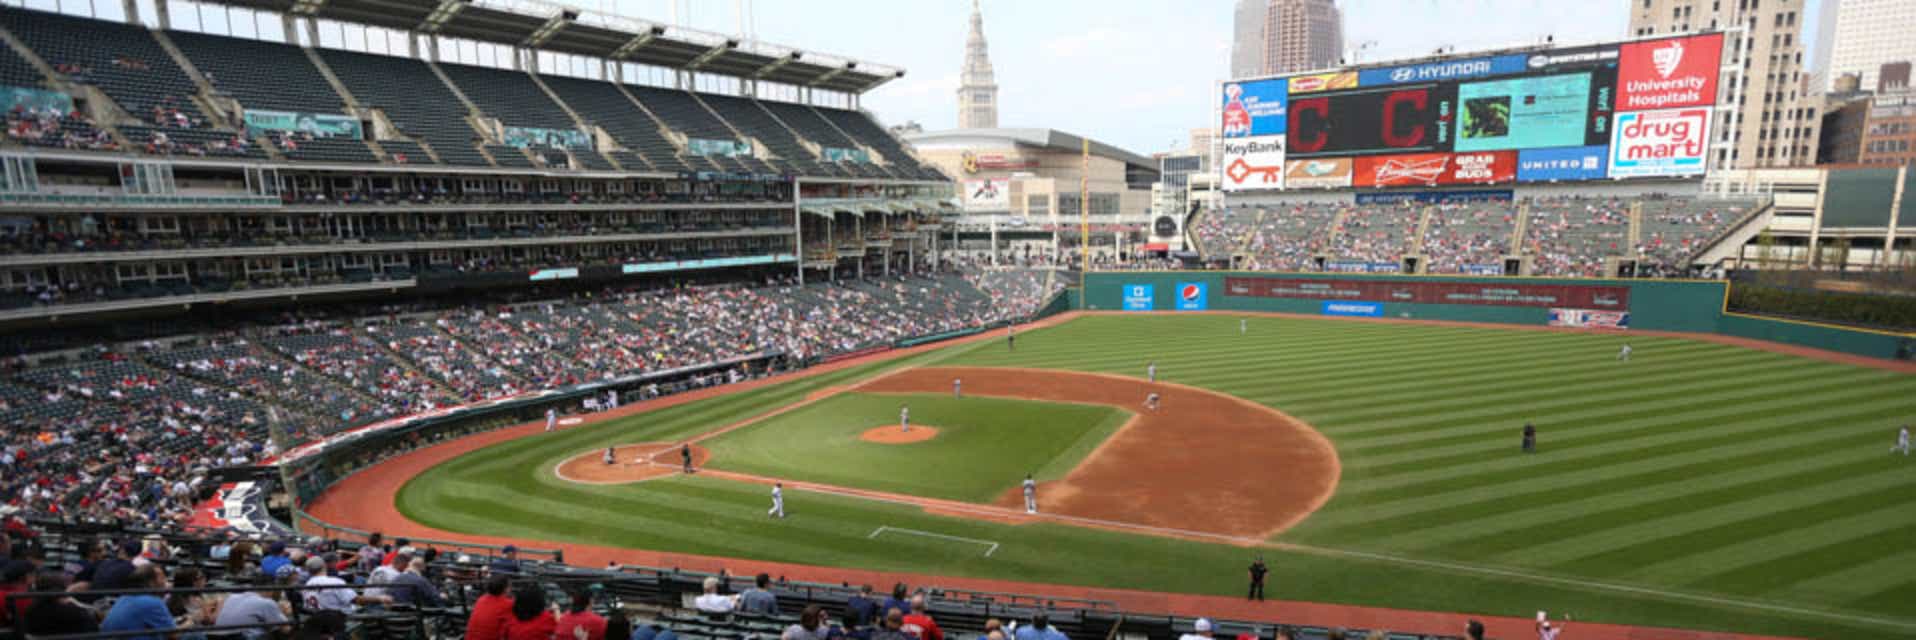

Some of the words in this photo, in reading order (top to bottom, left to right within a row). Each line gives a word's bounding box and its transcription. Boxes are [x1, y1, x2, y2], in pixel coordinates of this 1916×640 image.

[1418, 61, 1491, 79] HYUNDAI
[1627, 76, 1706, 93] University
[1629, 90, 1700, 106] Hospitals
[1624, 113, 1690, 143] drug
[1225, 140, 1282, 156] KeyBank
[1628, 139, 1698, 160] mart
[1522, 159, 1581, 170] UNITED
[1455, 168, 1493, 179] BUDS
